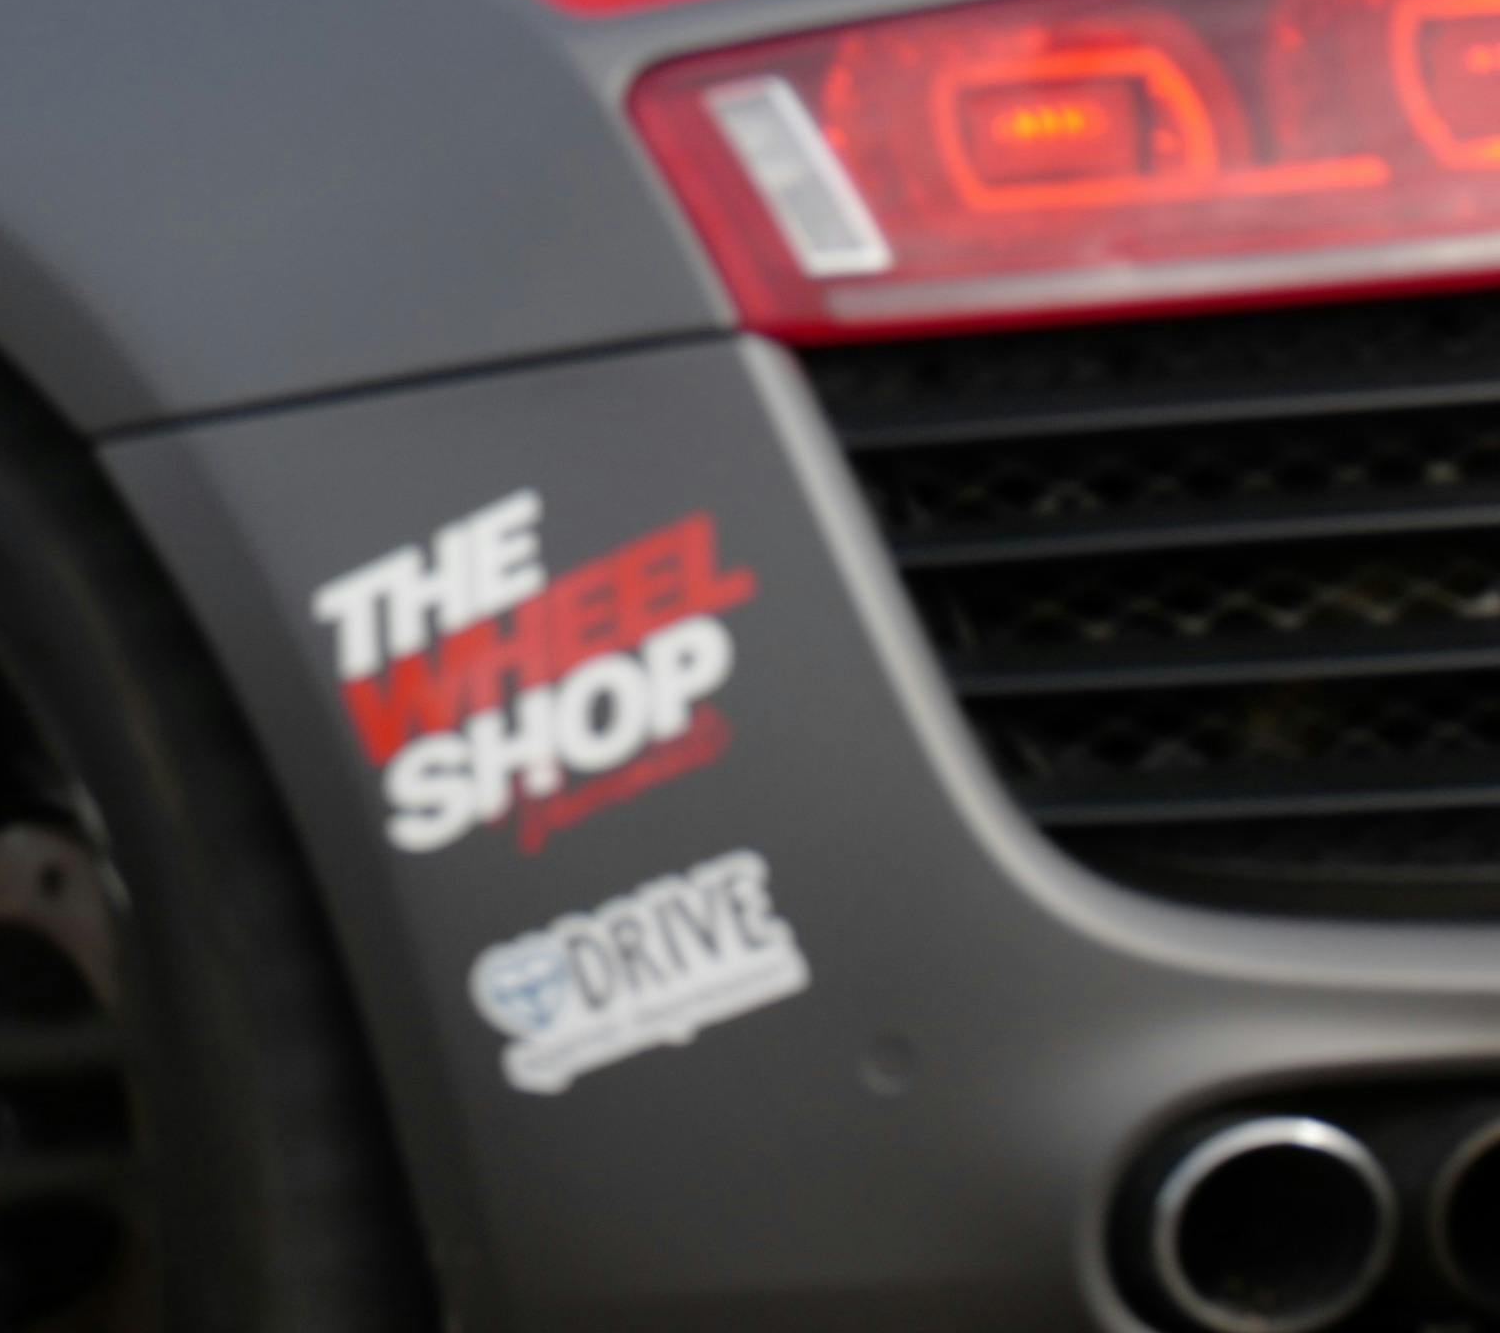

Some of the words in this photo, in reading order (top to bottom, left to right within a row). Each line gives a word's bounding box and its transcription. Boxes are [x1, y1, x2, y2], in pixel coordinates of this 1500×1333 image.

[312, 488, 548, 681] THE
[340, 508, 758, 769] WHEEL
[383, 613, 735, 853] SHOP
[563, 873, 772, 1014] DRIVE
